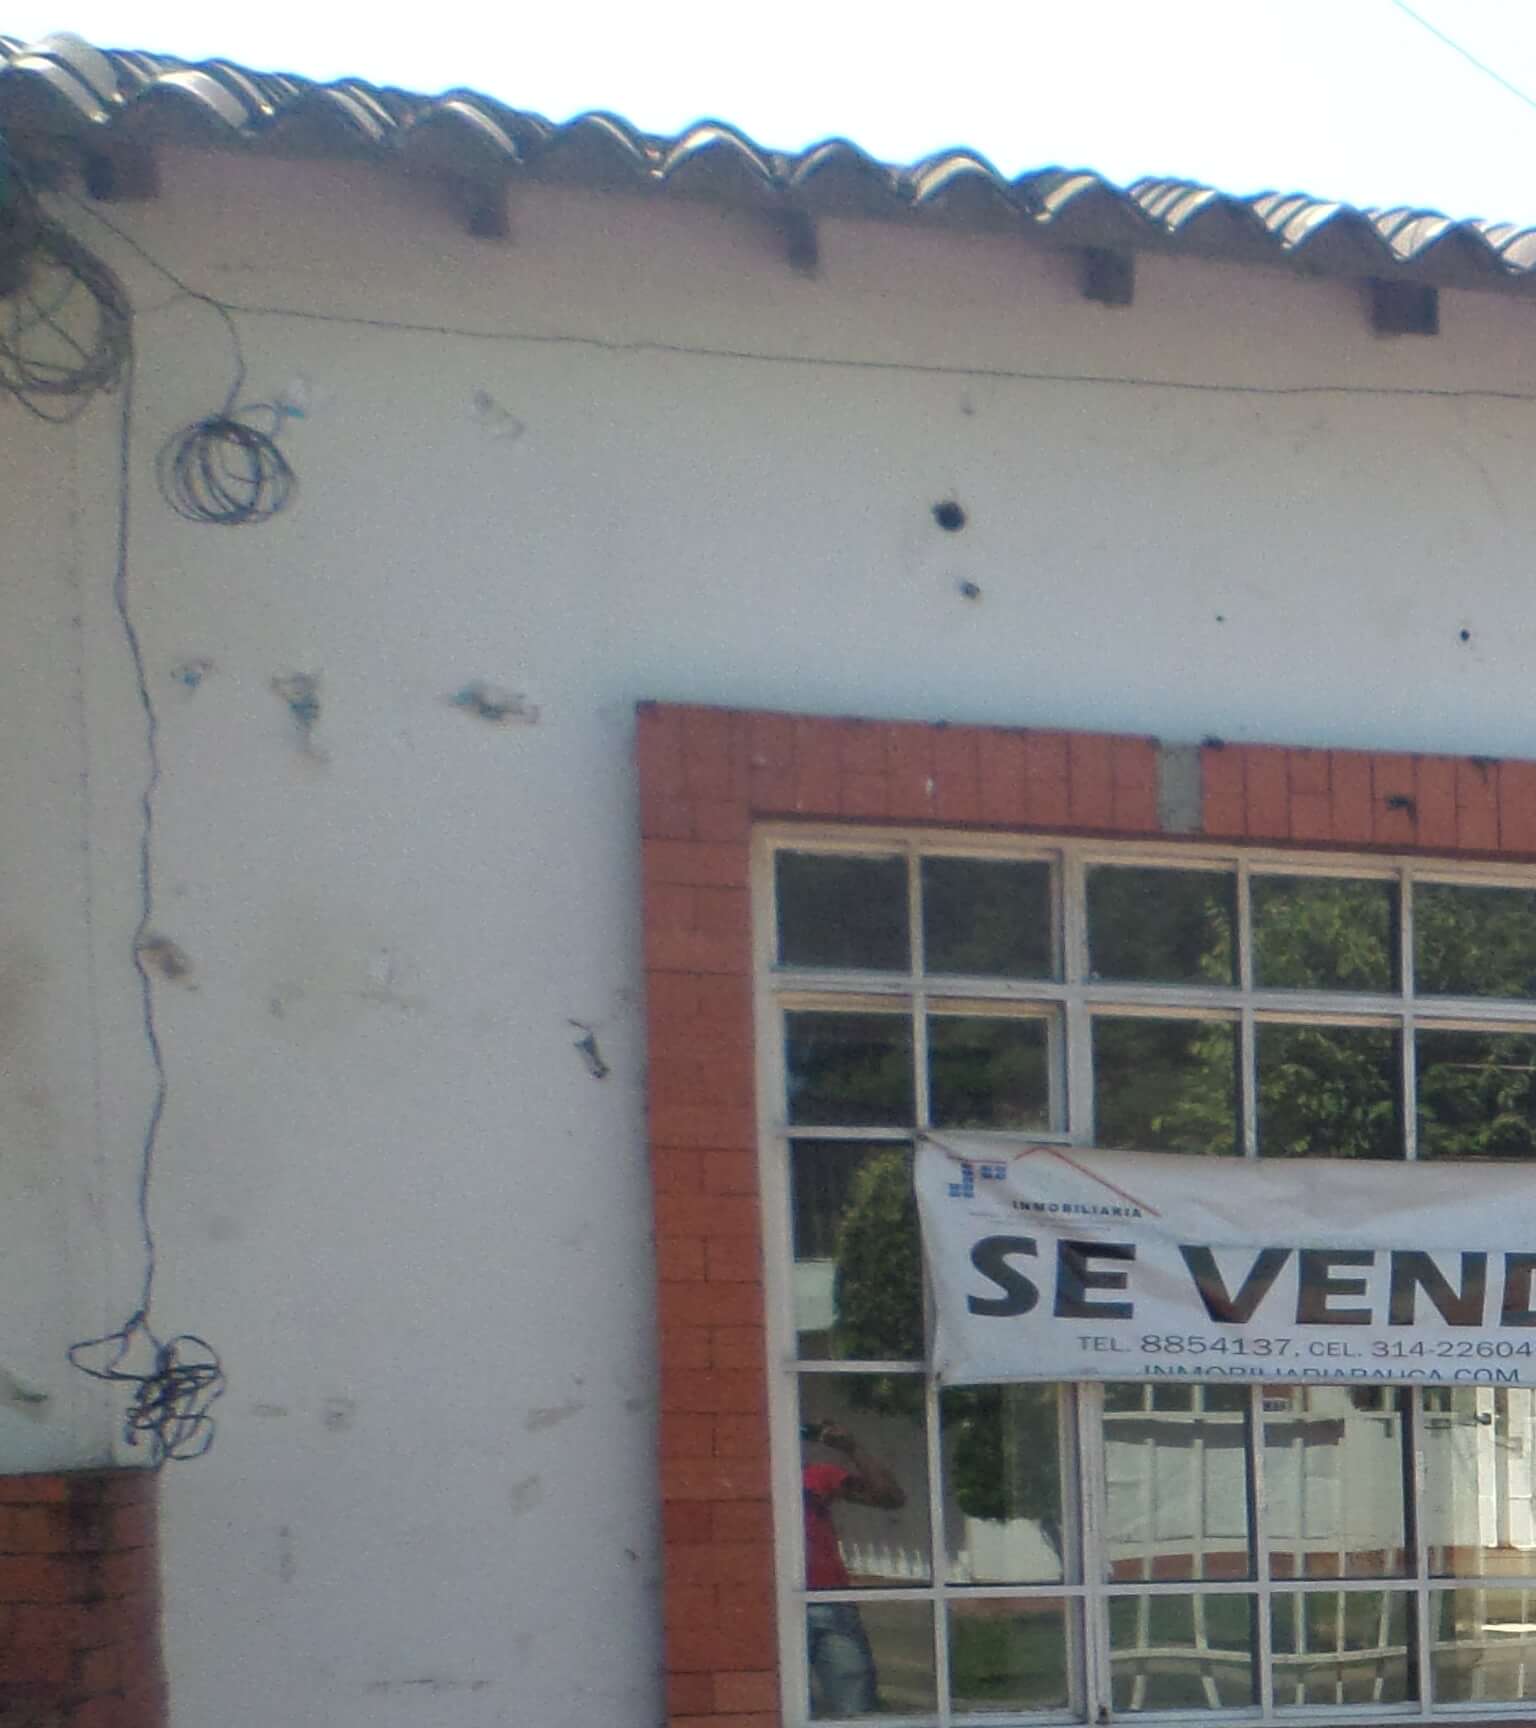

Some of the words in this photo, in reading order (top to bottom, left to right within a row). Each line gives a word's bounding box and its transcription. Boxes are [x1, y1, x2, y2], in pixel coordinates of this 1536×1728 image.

[1012, 1199, 1142, 1218] INMOBILIARIA
[967, 1234, 1136, 1319] SE
[1309, 1341, 1363, 1357] CEL.
